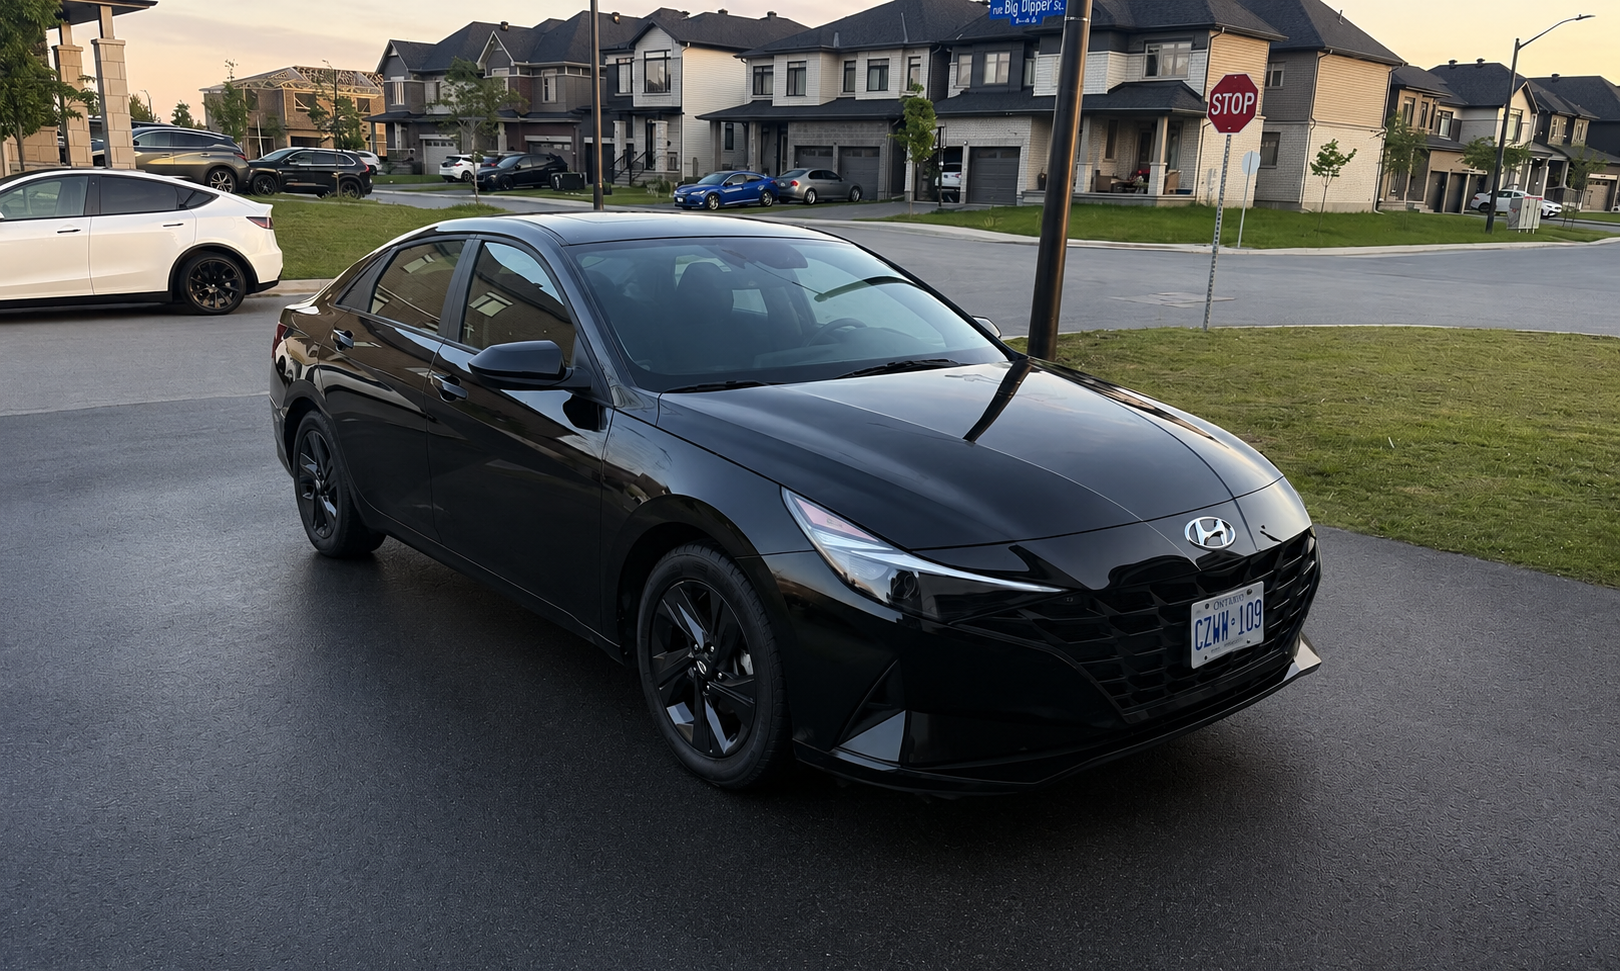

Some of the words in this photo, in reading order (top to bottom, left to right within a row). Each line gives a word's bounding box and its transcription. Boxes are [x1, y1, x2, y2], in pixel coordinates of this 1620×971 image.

[1004, 0, 1019, 17] Big
[1021, 0, 1052, 16] Dipper
[1211, 92, 1255, 115] STOP
